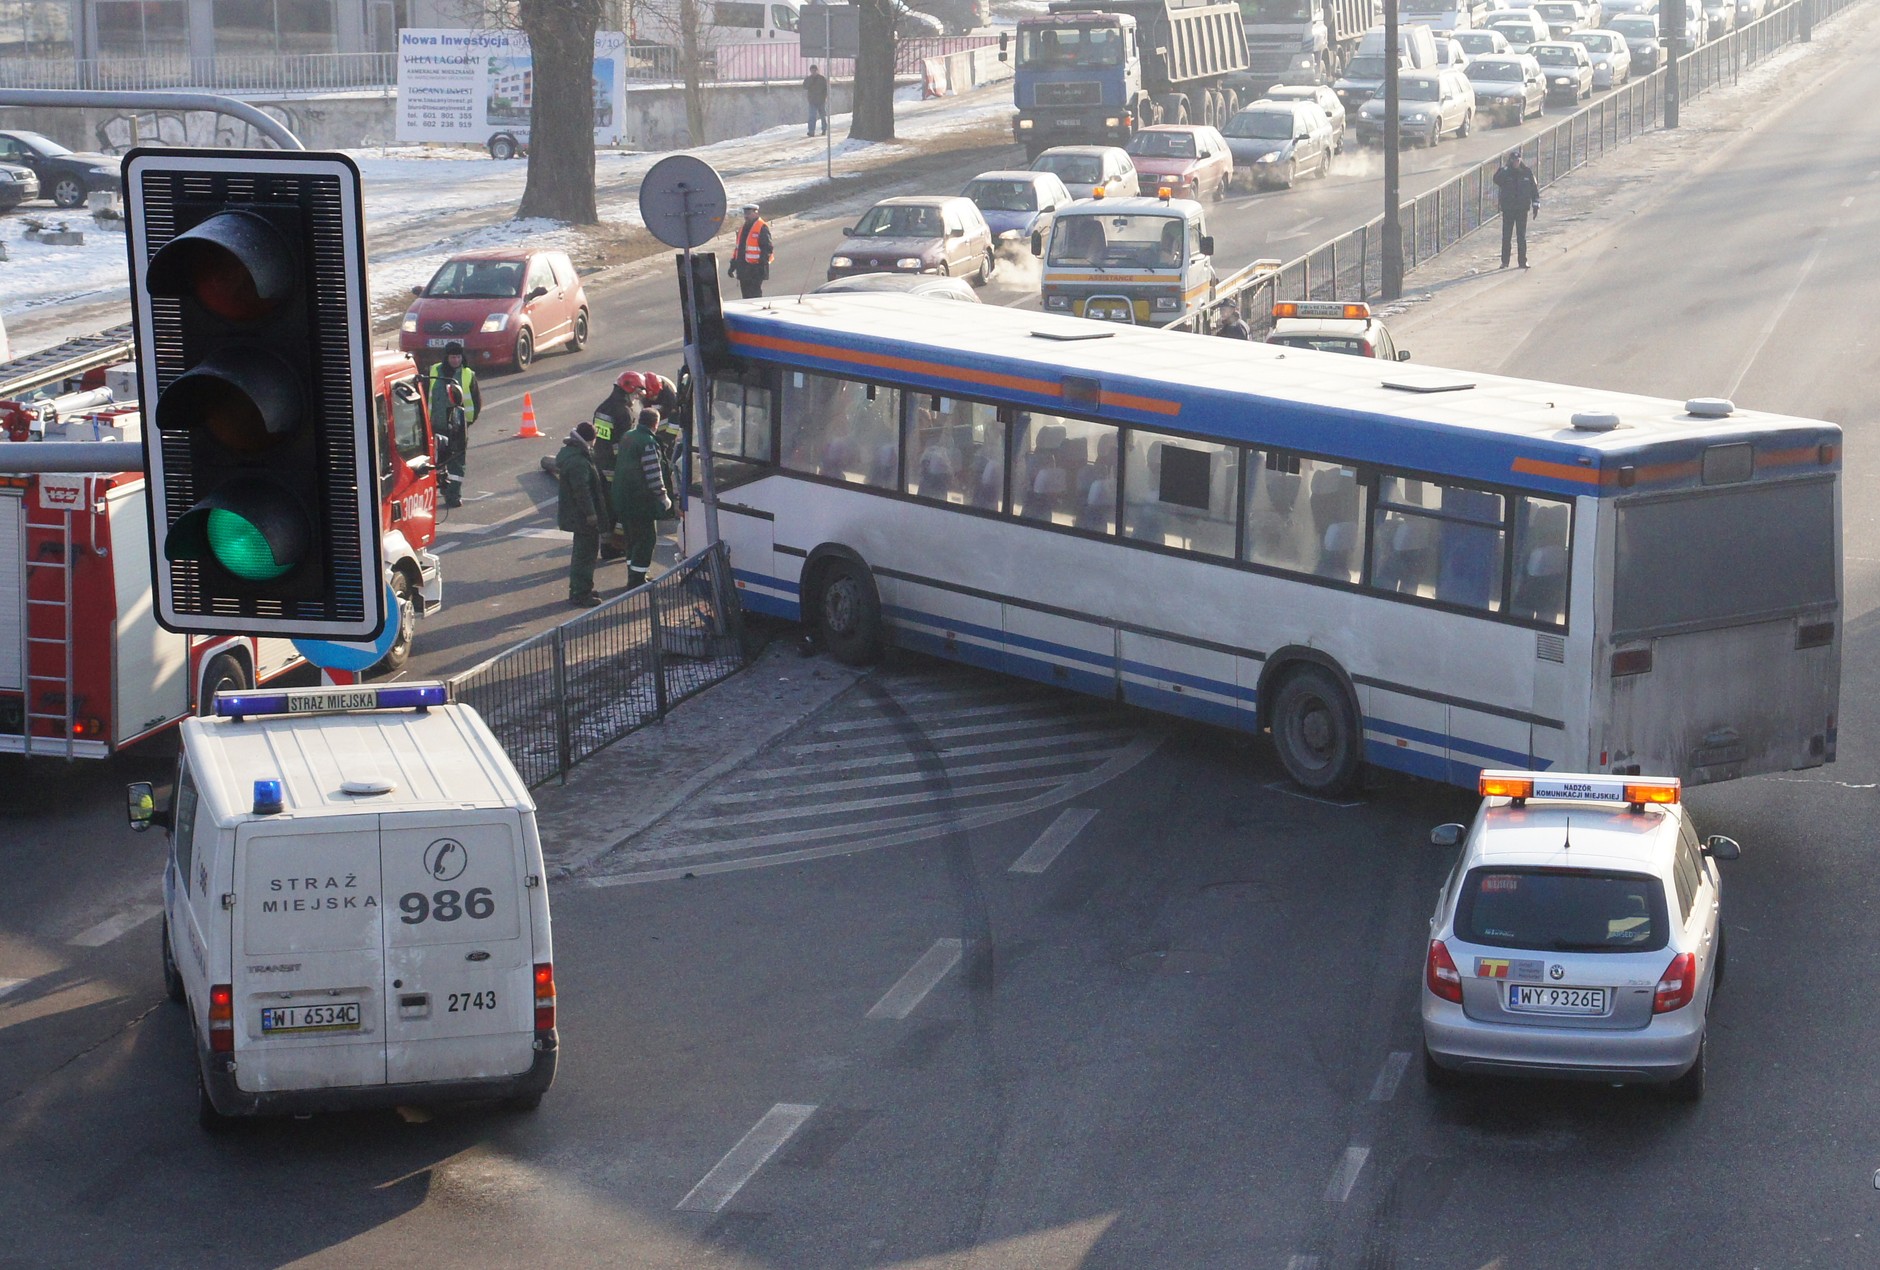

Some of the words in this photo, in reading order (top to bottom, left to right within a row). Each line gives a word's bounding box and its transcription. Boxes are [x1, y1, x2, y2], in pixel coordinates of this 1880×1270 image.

[402, 34, 437, 46] Nowa
[441, 34, 510, 48] Inwestycja
[404, 55, 431, 65] VILLA
[327, 694, 374, 709] MIEJSKA
[1536, 790, 1583, 799] KOMUNIKACJI
[1563, 784, 1592, 792] NADZÓR
[270, 872, 358, 892] STRAŻ
[262, 894, 378, 913] MIEJSKA
[399, 886, 496, 925] 986
[247, 963, 302, 973] TRANSIT
[448, 990, 497, 1013] 2743
[1521, 987, 1544, 1005] WY
[1550, 989, 1601, 1008] 9326E
[273, 1009, 294, 1027] WI
[304, 1006, 357, 1025] 6534C
